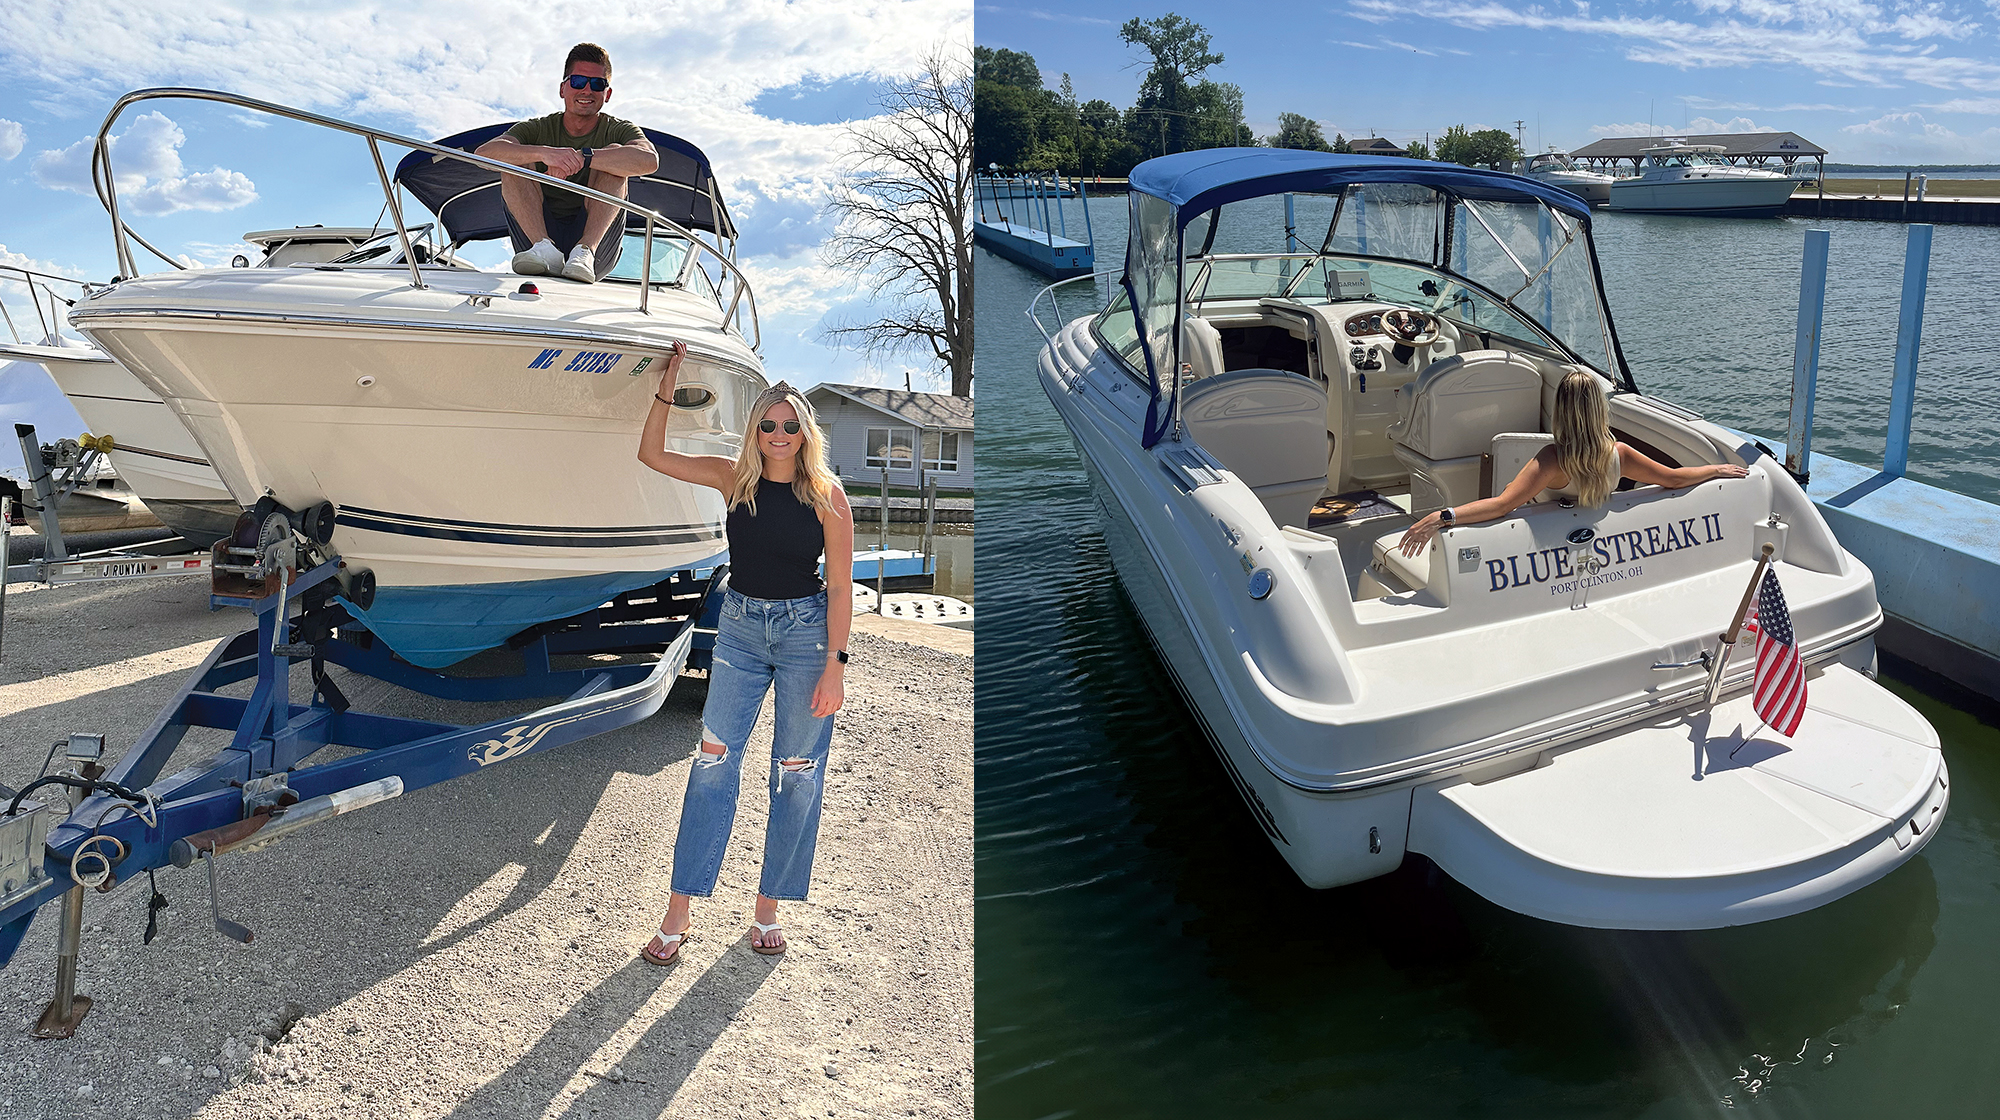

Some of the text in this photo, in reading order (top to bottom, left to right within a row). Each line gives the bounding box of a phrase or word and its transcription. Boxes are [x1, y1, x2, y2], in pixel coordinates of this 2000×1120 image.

[1054, 247, 1064, 257] 10
[1084, 246, 1091, 256] 11
[1072, 257, 1079, 267] E
[527, 348, 563, 369] MC
[1485, 546, 1574, 593] BLUE
[1592, 518, 1701, 568] STREAK
[1702, 512, 1724, 543] II
[103, 562, 147, 577] J RUNYAN
[1550, 566, 1643, 596] PORT CLINTON, OH
